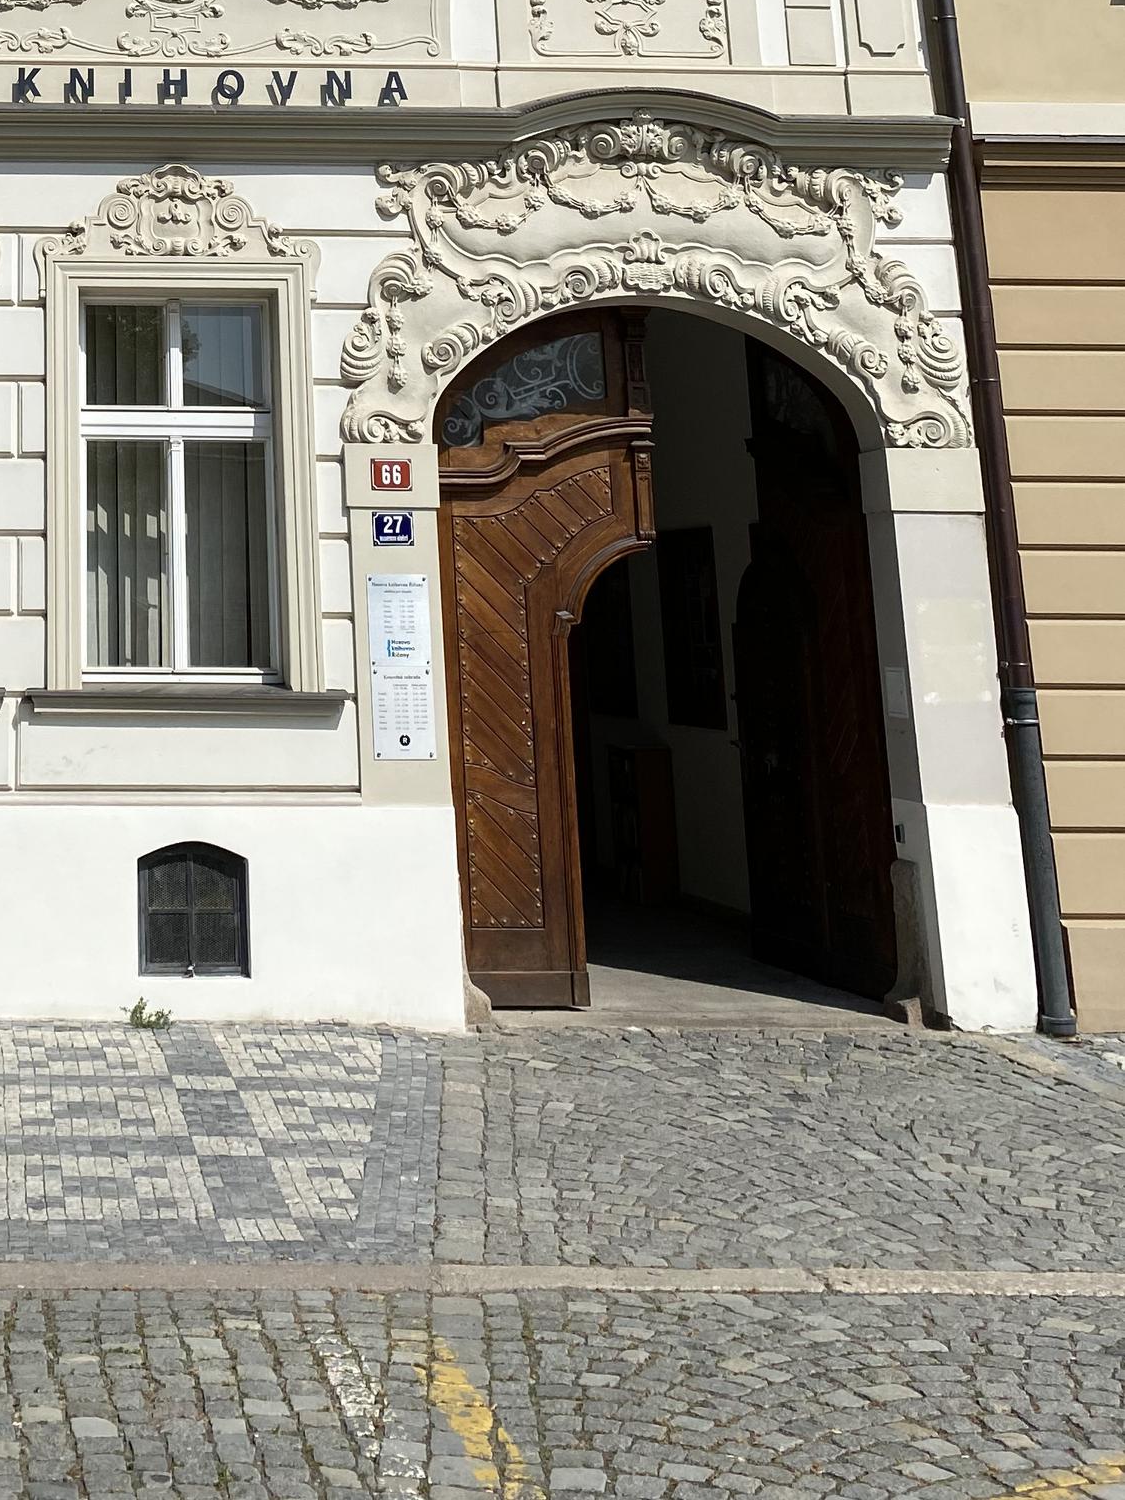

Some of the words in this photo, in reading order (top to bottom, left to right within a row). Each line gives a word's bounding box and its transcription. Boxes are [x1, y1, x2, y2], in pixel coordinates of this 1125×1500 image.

[17, 67, 408, 100] KNIHOVNA
[381, 464, 402, 485] 66
[383, 515, 403, 534] 27
